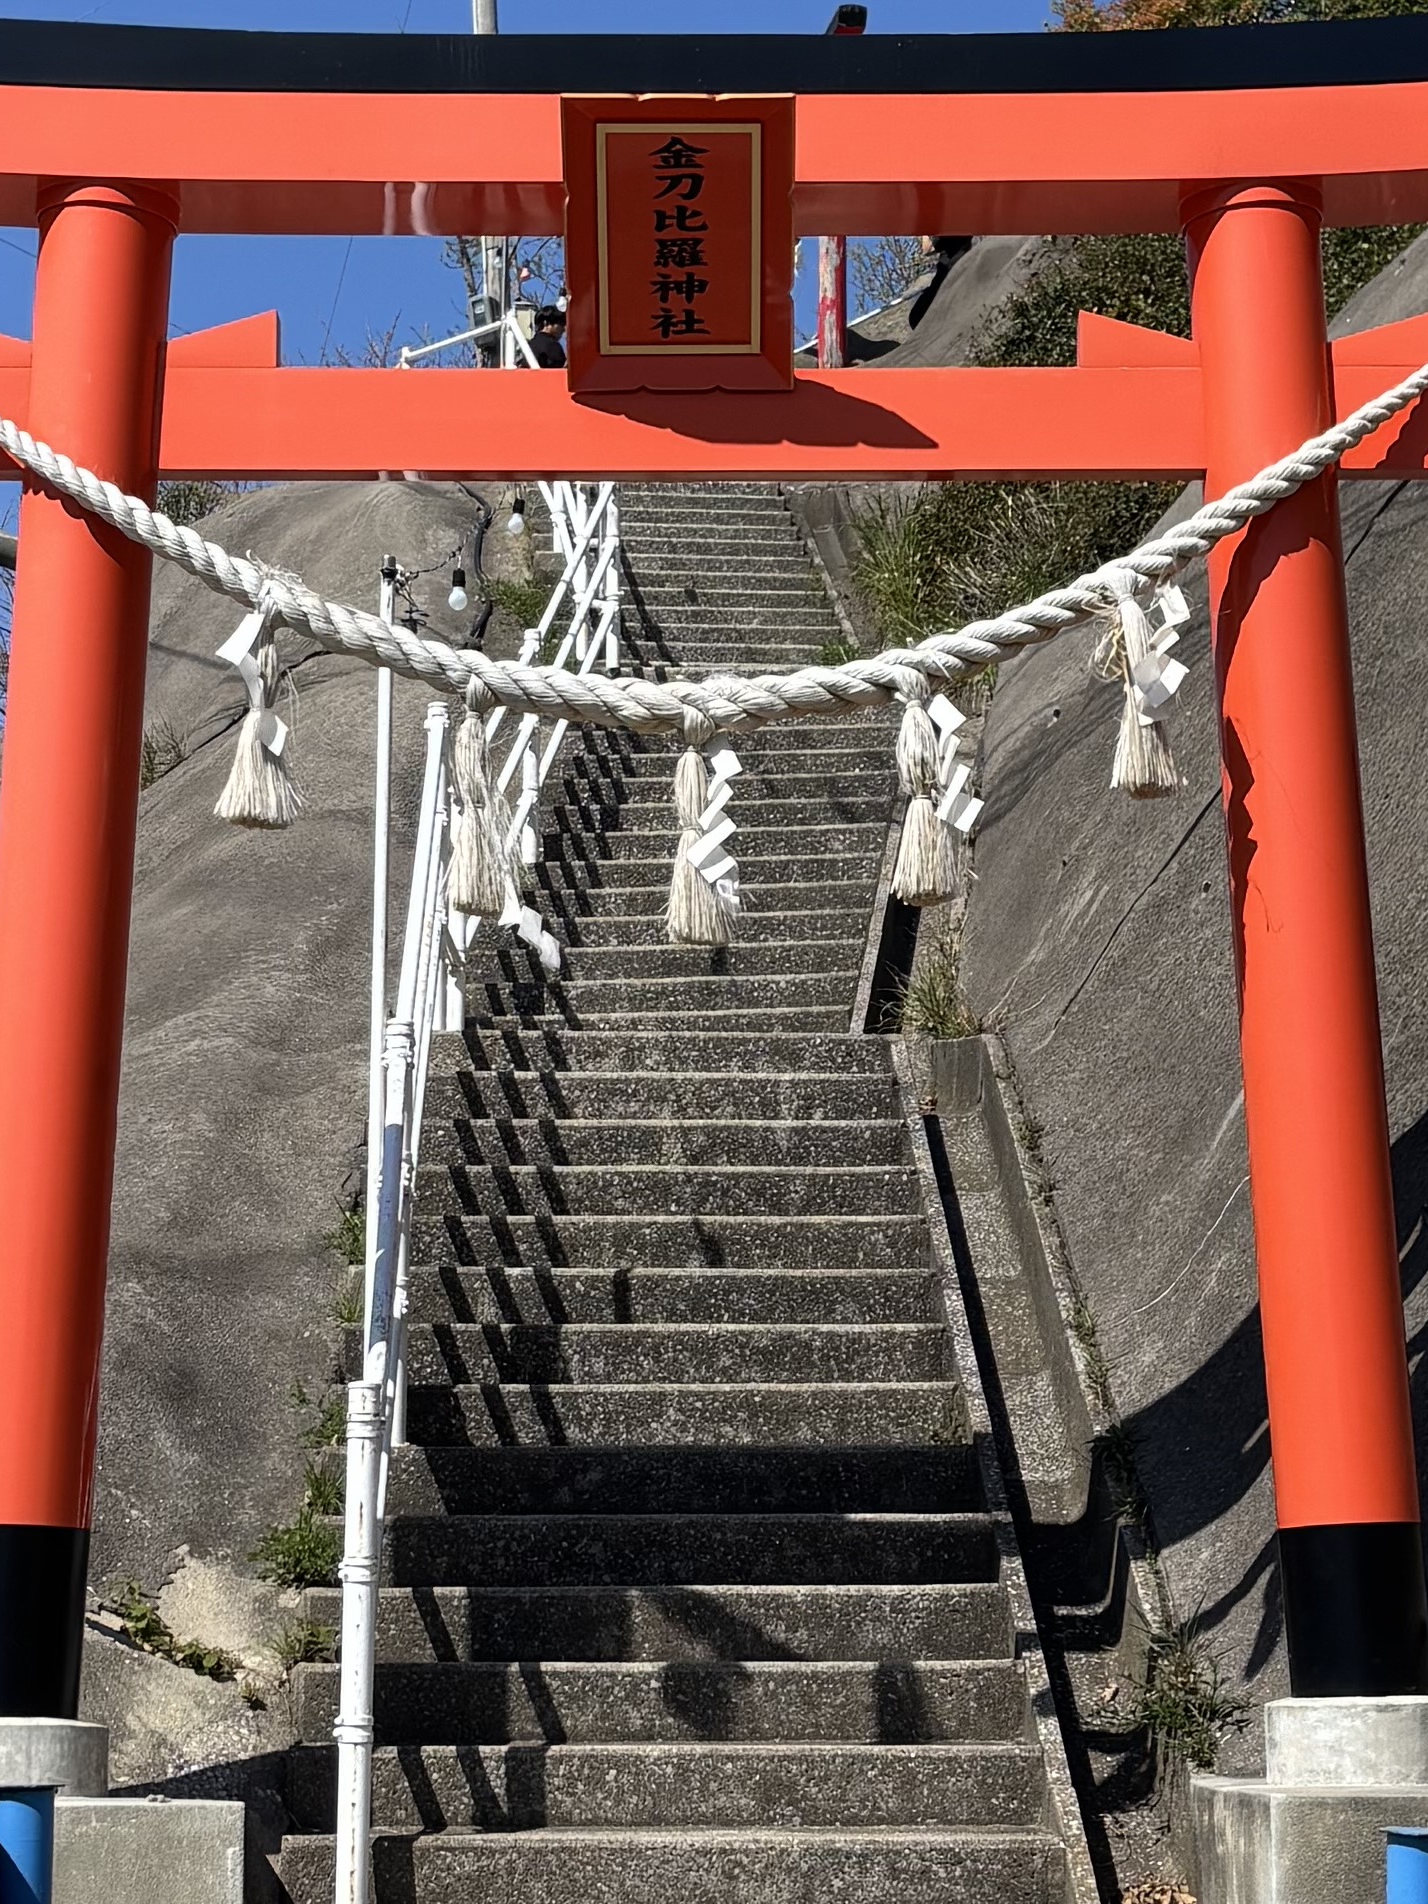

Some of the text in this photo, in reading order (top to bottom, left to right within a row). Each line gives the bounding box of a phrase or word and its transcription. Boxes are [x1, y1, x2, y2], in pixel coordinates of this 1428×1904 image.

[648, 136, 711, 339] 金刀比羅神社
